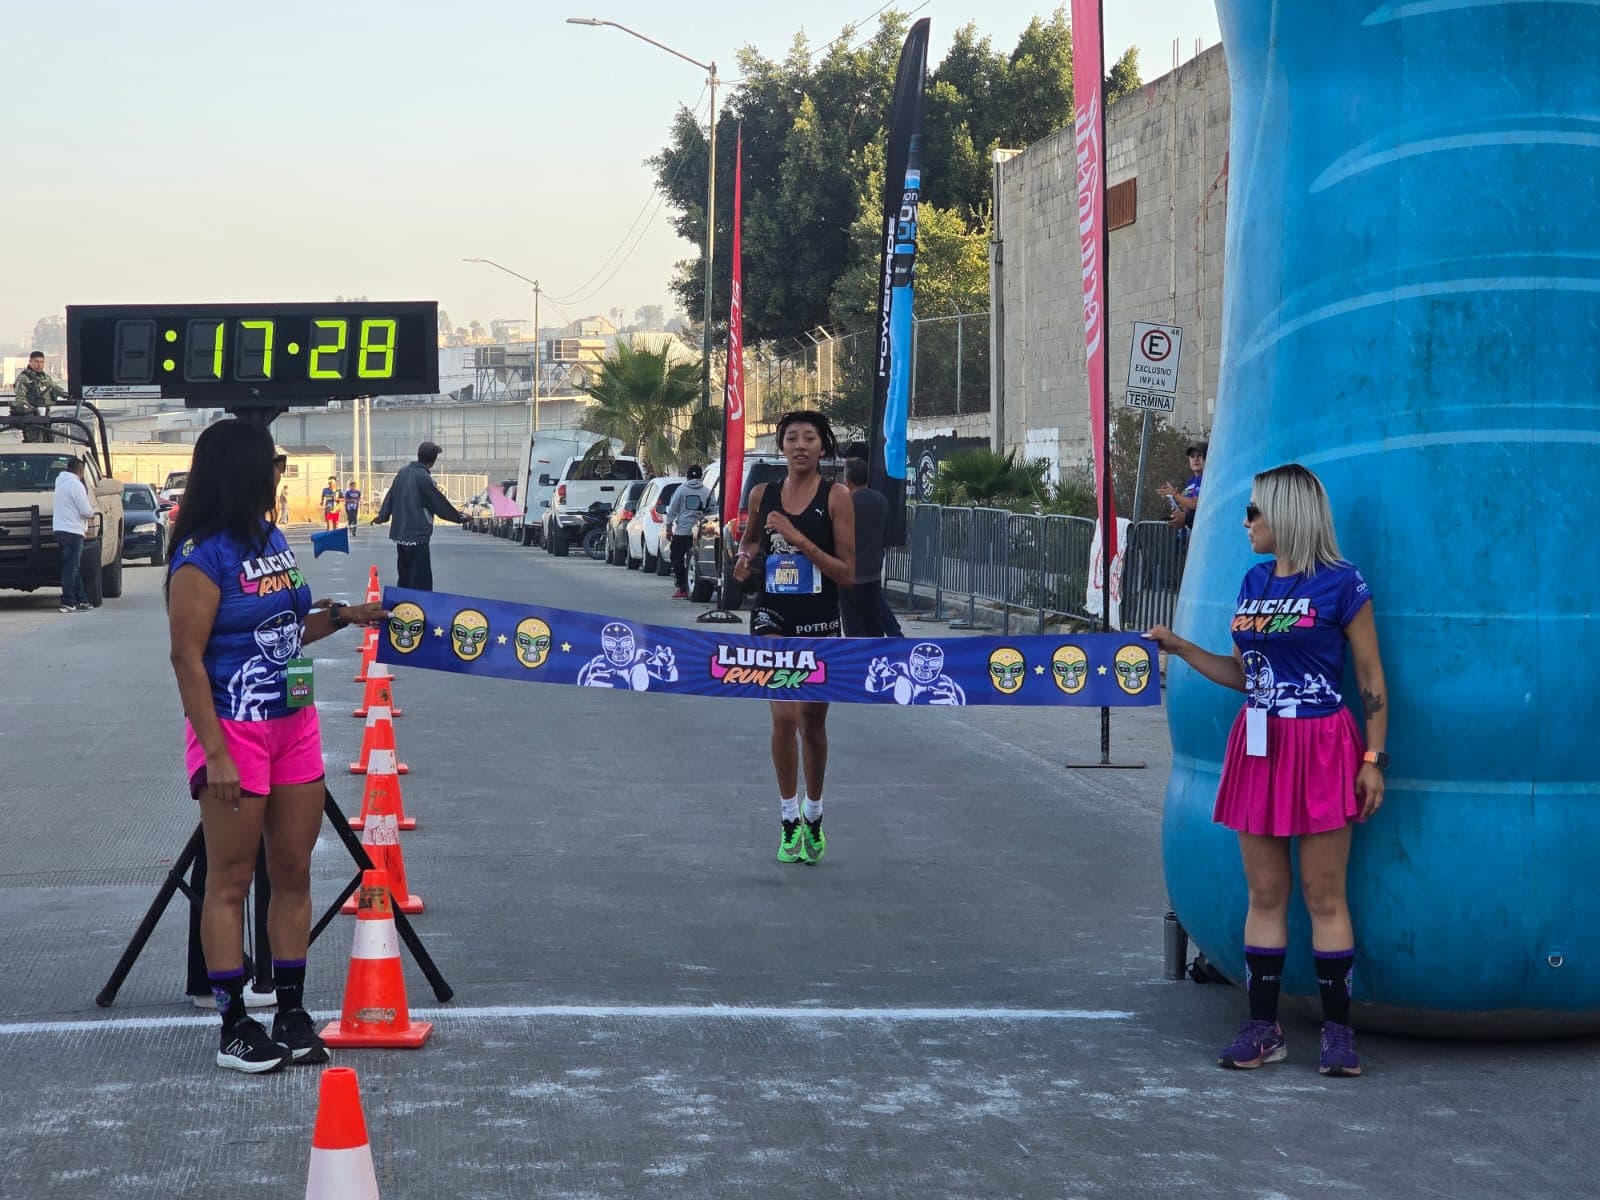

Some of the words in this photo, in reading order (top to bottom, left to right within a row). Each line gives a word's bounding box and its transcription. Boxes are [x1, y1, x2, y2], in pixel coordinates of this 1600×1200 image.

[879, 215, 895, 377] POWERADE
[1148, 334, 1164, 356] E
[1135, 364, 1172, 376] EXCLUSIVO
[1139, 376, 1166, 387] IMPLAN
[1129, 393, 1171, 410] TERMINA
[1237, 598, 1311, 616] LUCHA
[717, 644, 818, 670] LUCHA
